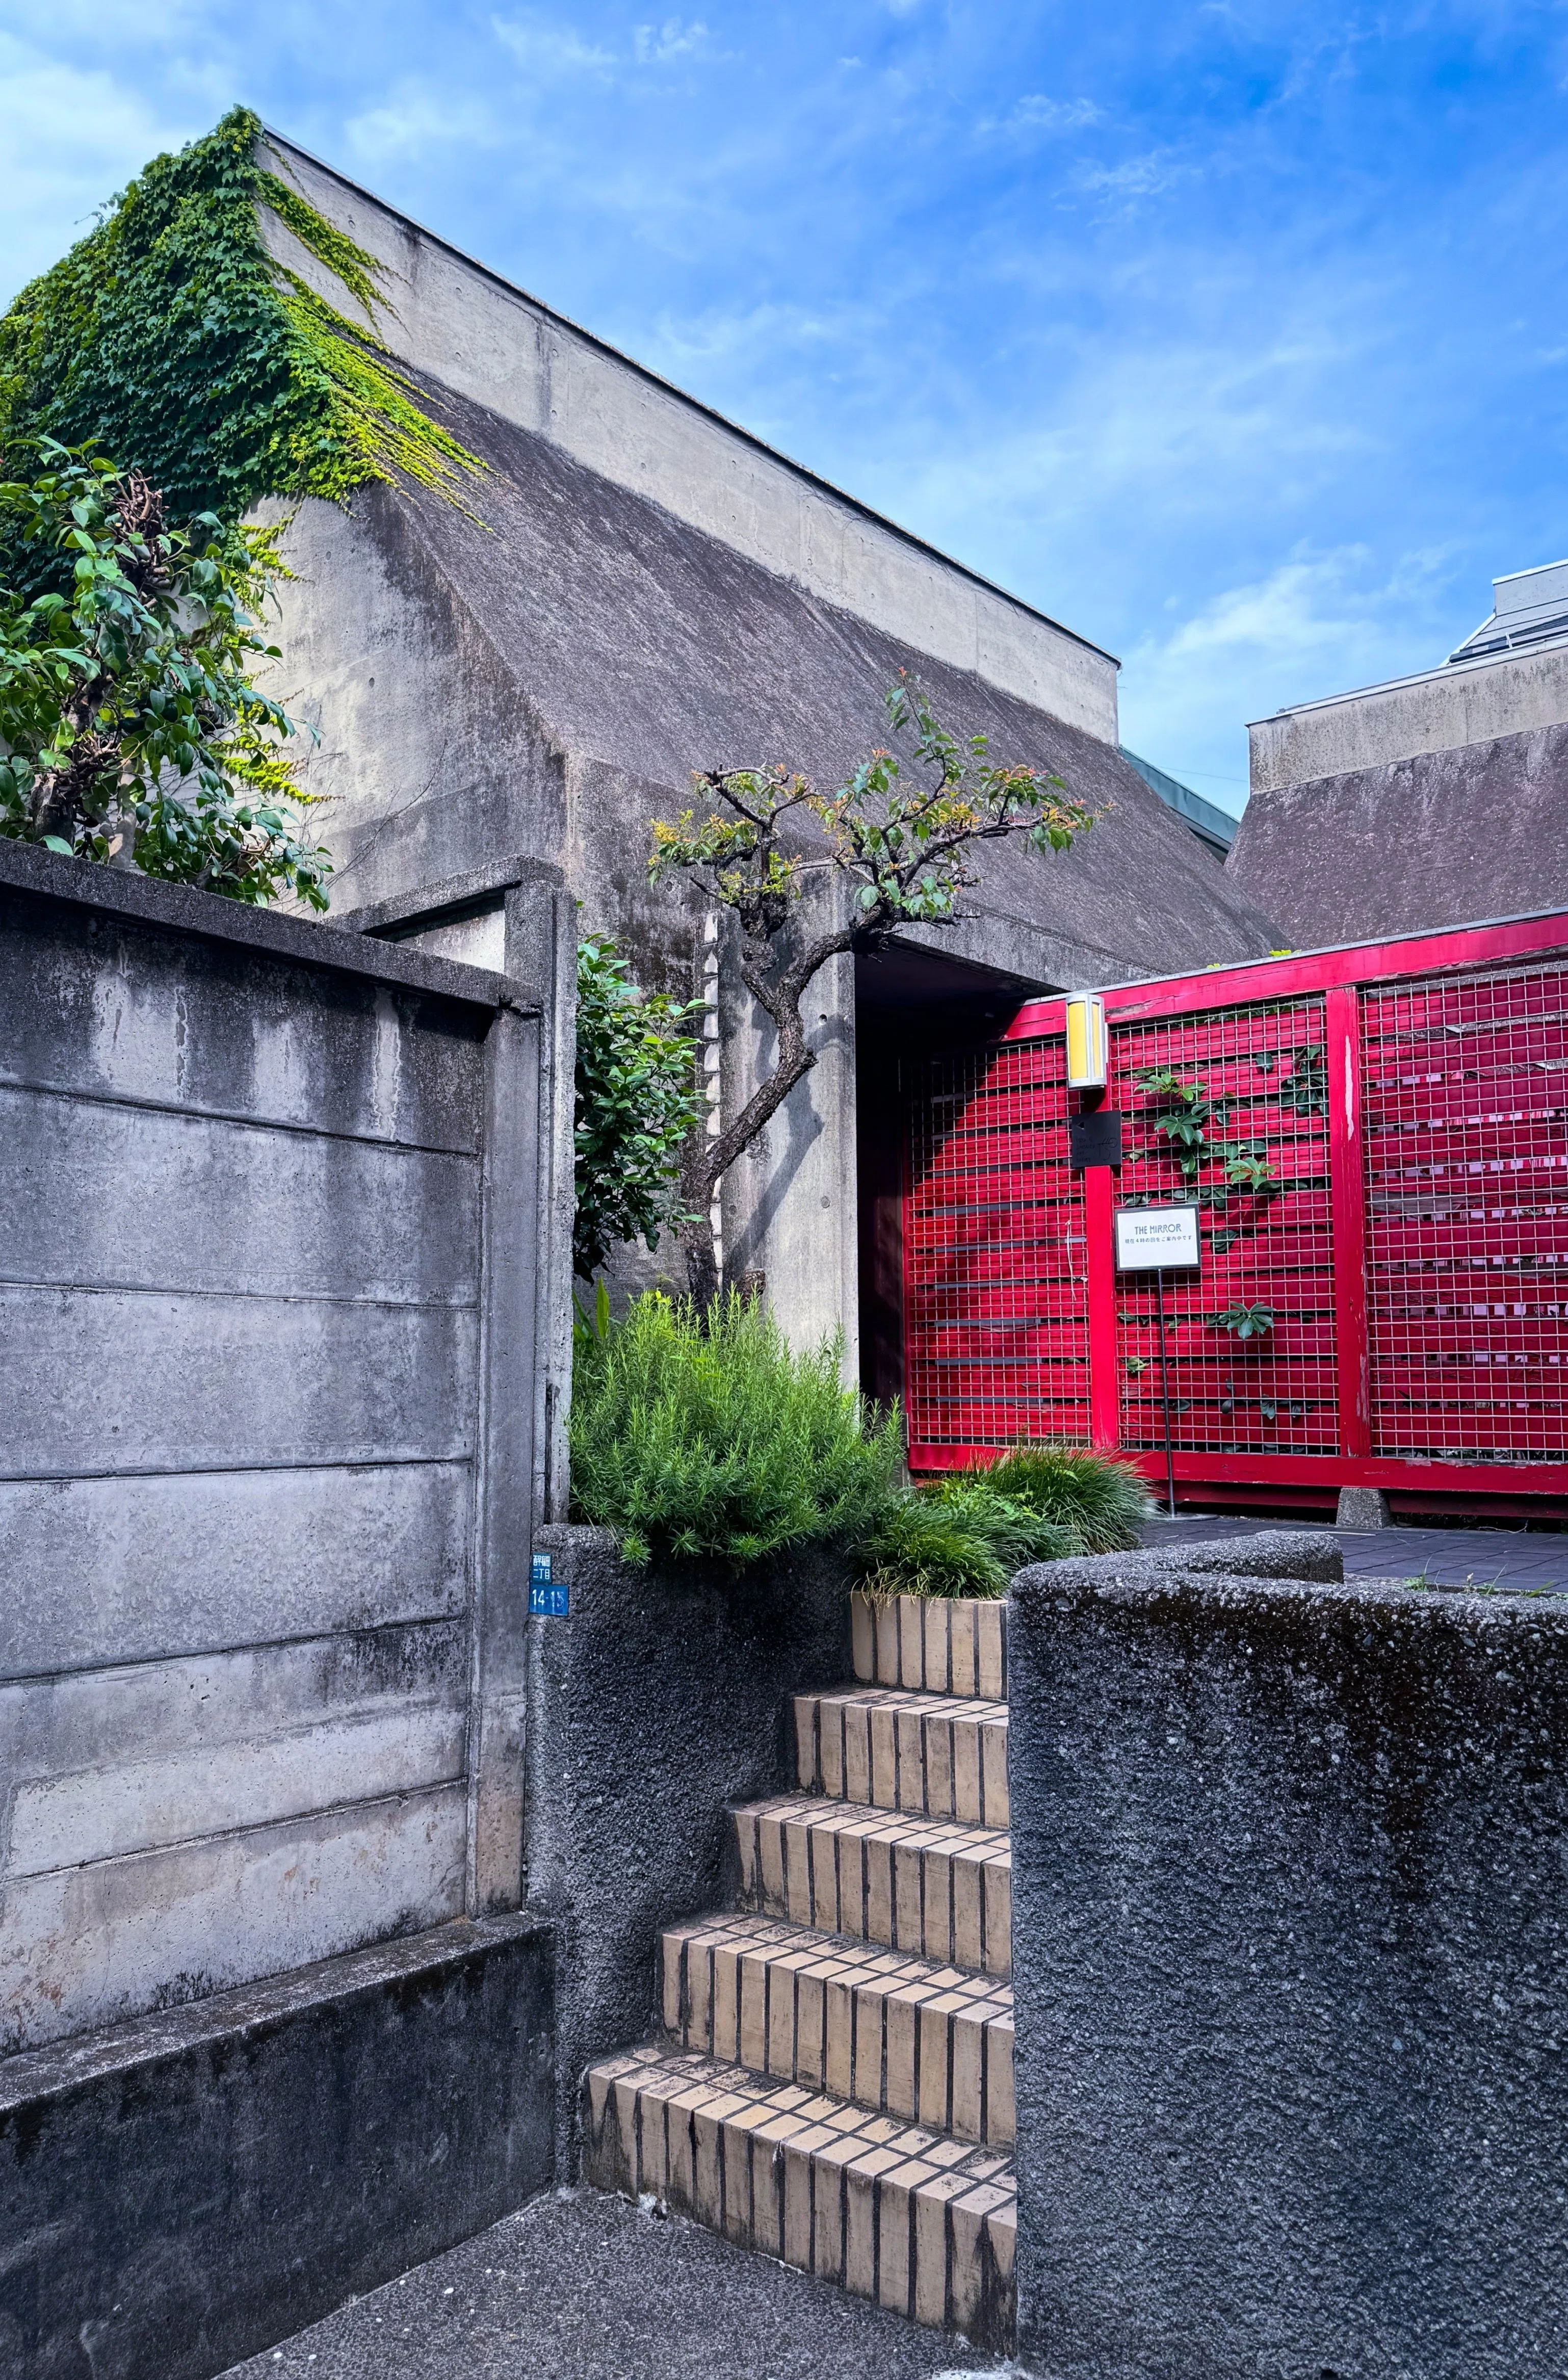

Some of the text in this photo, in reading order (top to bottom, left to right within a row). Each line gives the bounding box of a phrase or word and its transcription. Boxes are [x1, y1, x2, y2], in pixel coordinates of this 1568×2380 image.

[1135, 1223, 1182, 1235] THE MIRROR
[533, 1568, 550, 1580] 二丁目
